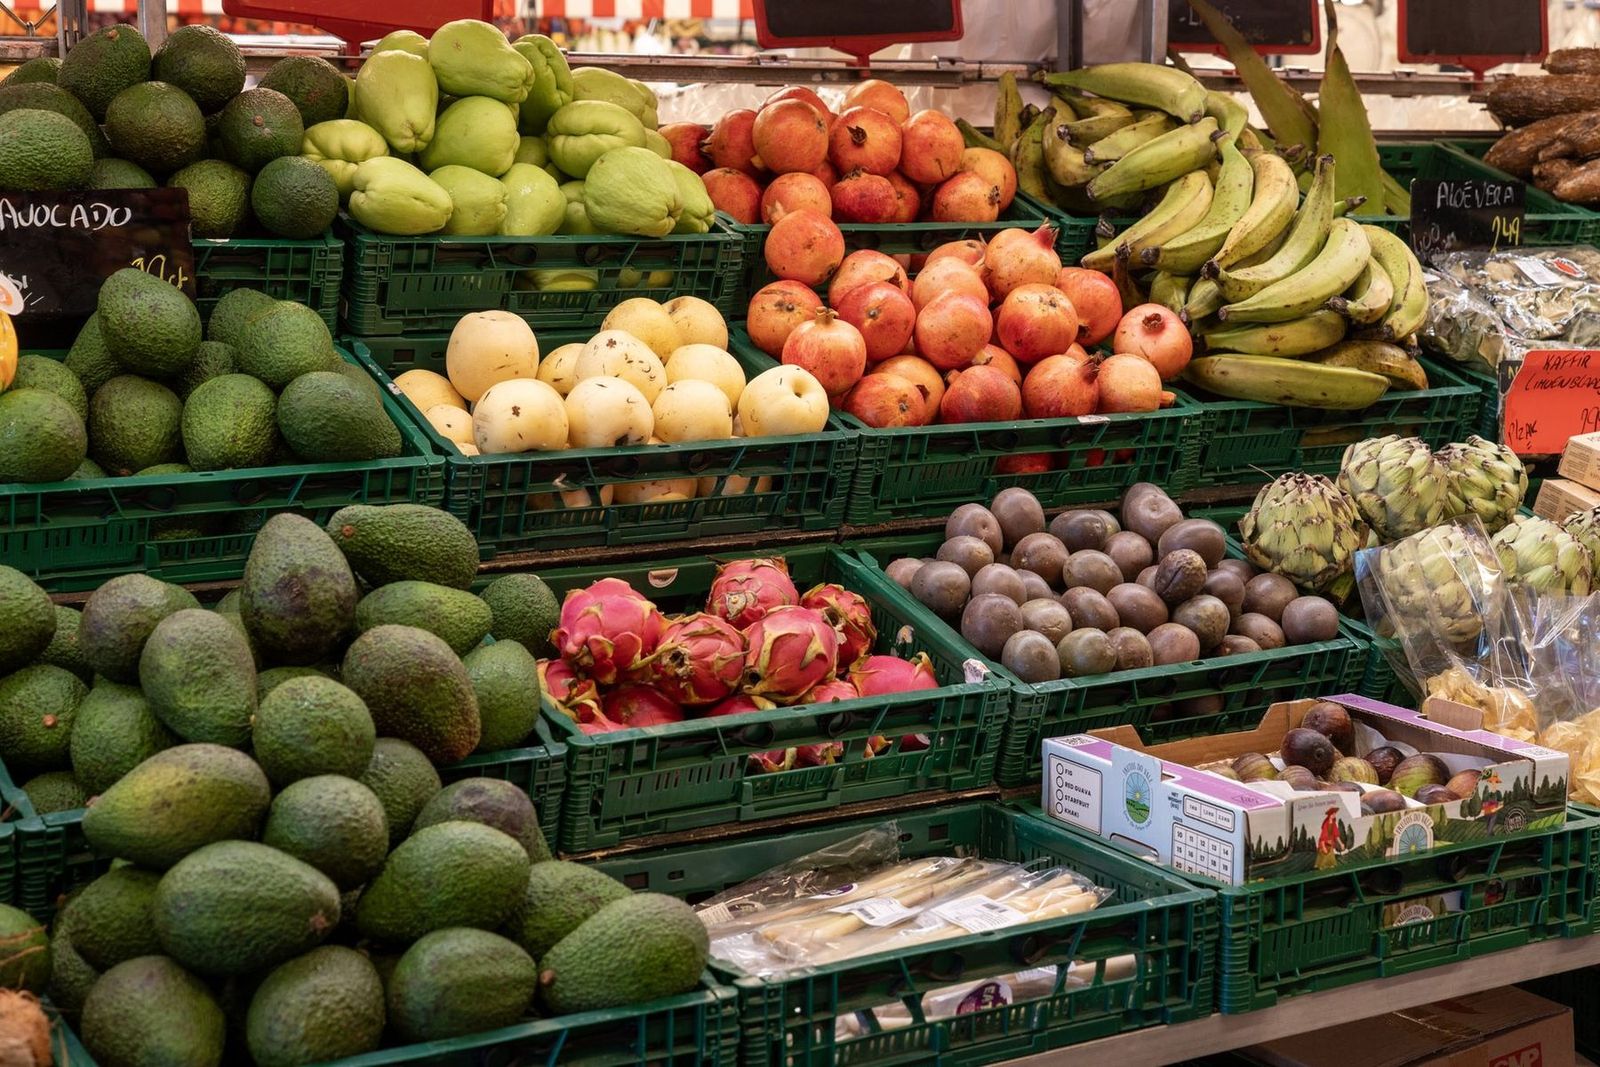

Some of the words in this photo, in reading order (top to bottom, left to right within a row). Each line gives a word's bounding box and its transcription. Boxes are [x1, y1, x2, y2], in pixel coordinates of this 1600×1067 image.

[0, 198, 132, 231] AVOCADO
[1543, 352, 1591, 371] KAFFIR
[1065, 768, 1073, 776] FIG
[1065, 781, 1074, 791] RED
[1075, 785, 1091, 796] GUAVA
[1065, 794, 1090, 809] STARFRUIT
[1064, 808, 1080, 818] KHAKI
[1395, 815, 1413, 834] FRUTOS
[1413, 813, 1421, 822] DO
[1421, 815, 1433, 828] VALE
[1223, 848, 1229, 856] 14
